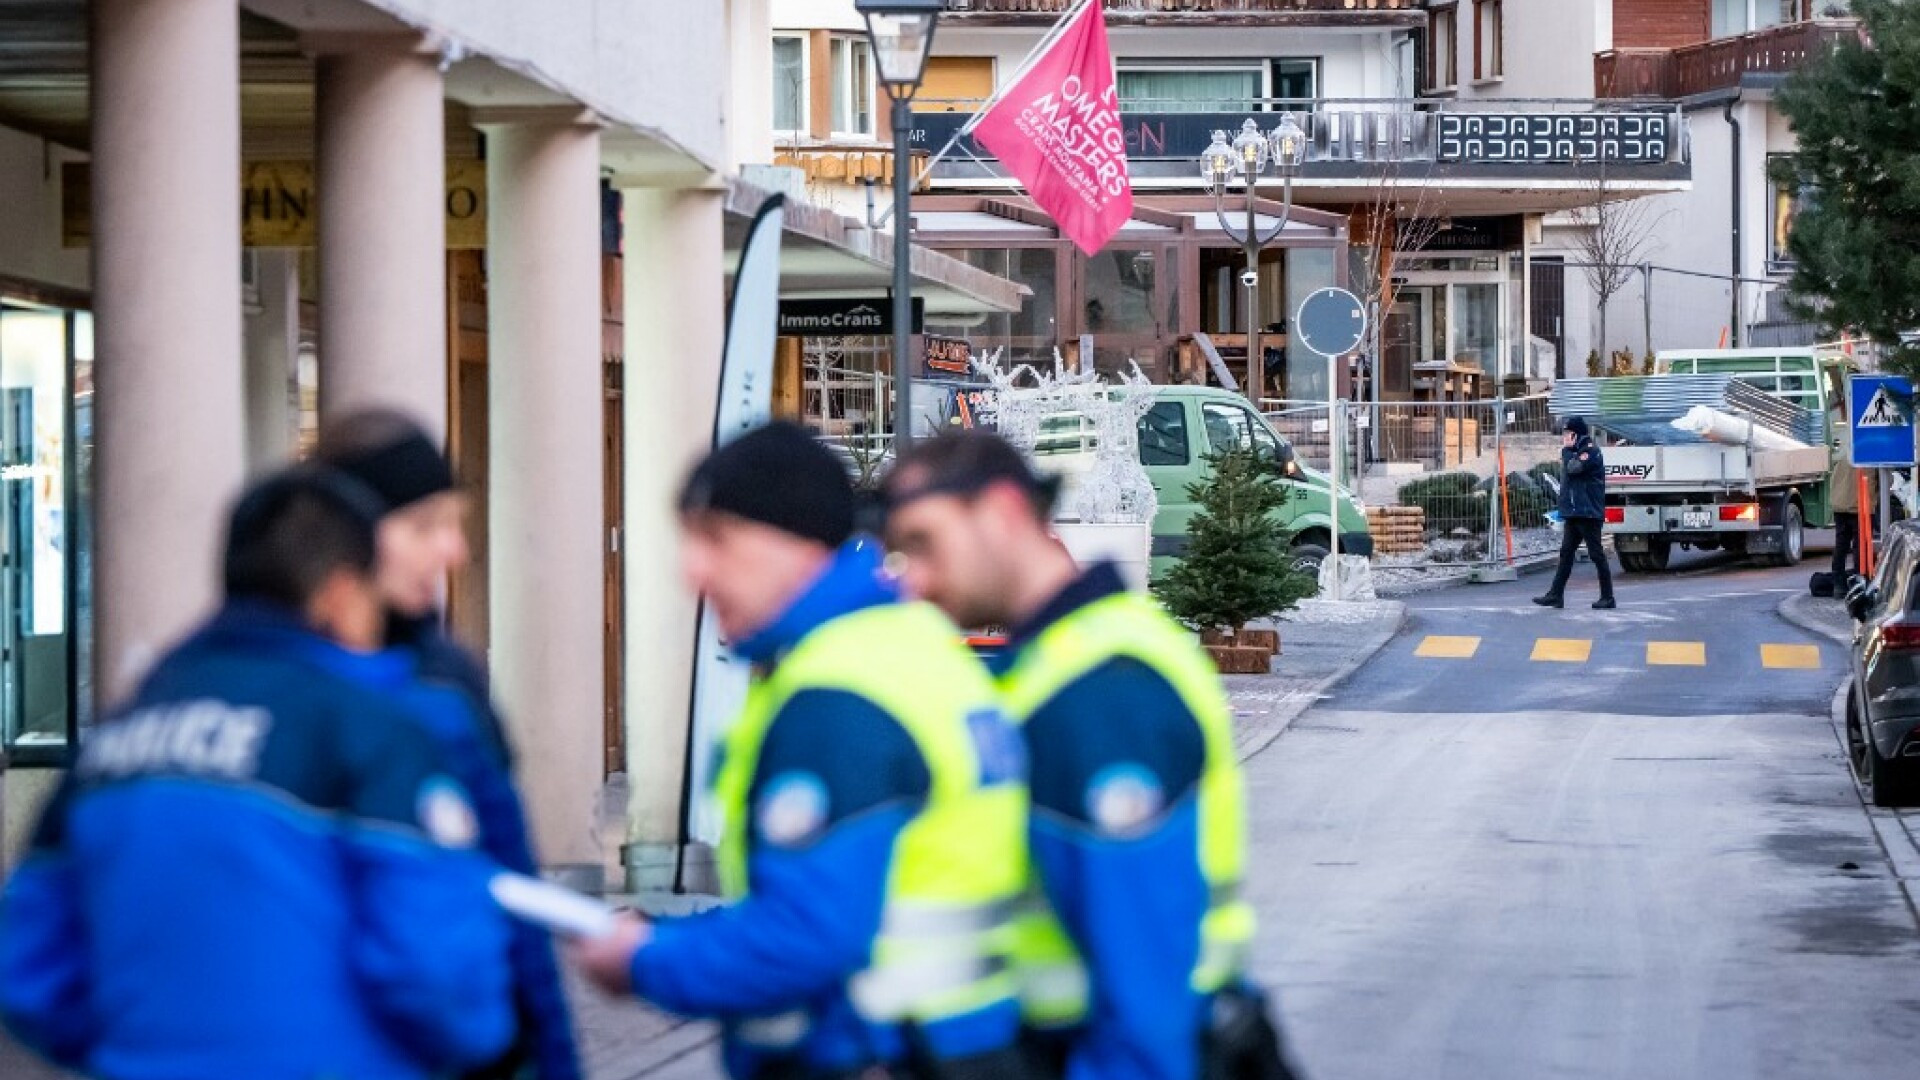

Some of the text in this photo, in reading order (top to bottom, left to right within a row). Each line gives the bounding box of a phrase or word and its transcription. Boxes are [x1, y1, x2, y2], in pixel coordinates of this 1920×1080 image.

[1021, 108, 1099, 196] CRANS MONTANA
[1032, 92, 1126, 196] MASTERS
[1061, 75, 1128, 178] OMEGA
[781, 312, 882, 328] ImmoCrans
